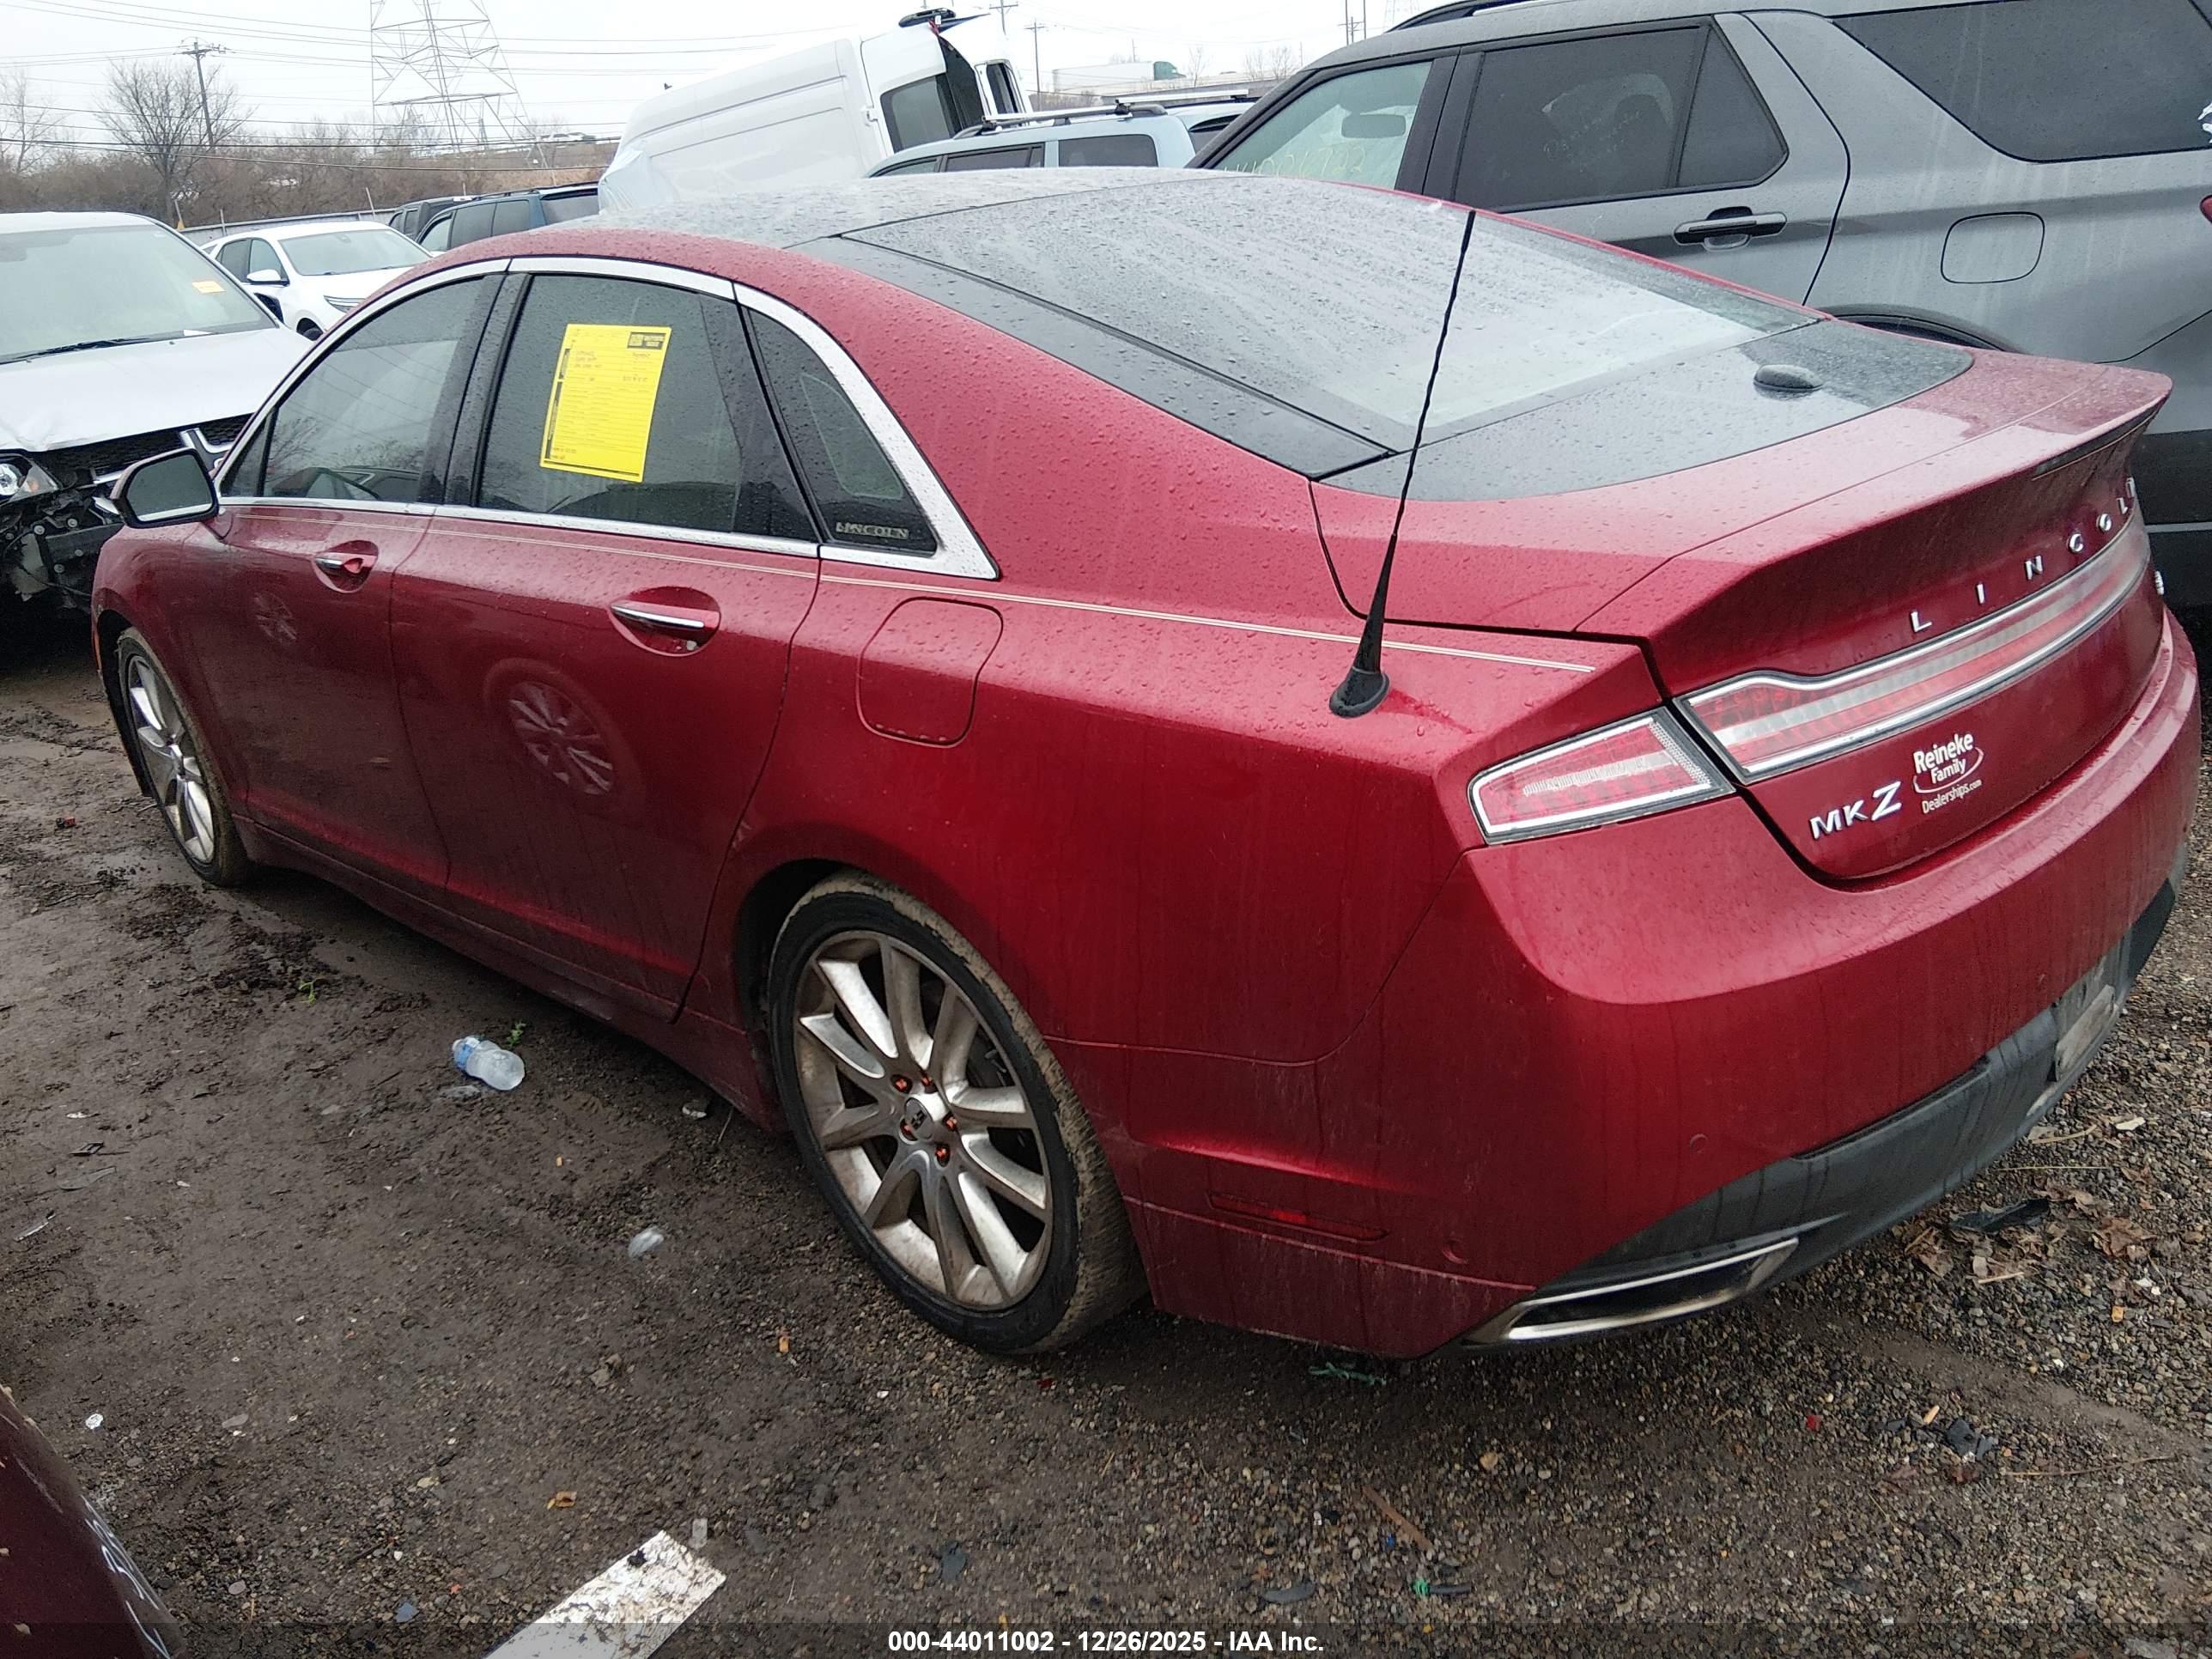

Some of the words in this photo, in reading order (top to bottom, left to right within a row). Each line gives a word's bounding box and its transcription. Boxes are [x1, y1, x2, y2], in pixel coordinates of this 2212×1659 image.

[836, 522, 908, 540] LINCOLN
[1913, 733, 1973, 774] Reineke
[1931, 759, 1966, 784] Family
[1809, 781, 1903, 839] MKZ
[1922, 780, 1983, 814] Dealerships.com
